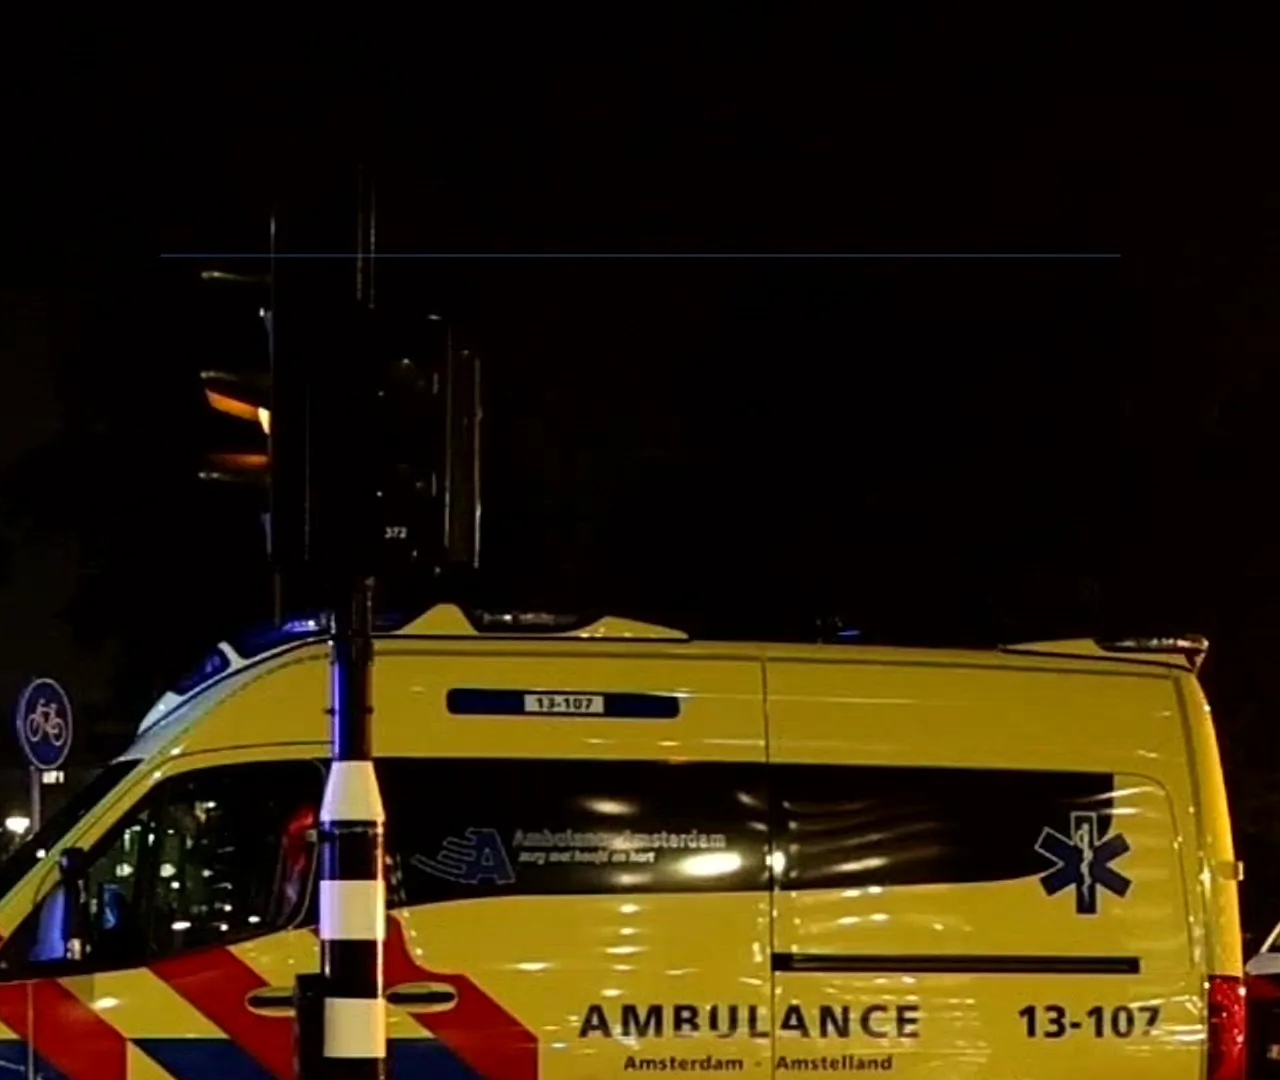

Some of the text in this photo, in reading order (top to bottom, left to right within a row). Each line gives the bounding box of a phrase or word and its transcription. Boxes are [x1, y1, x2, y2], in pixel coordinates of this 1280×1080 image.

[384, 525, 408, 540] 372
[535, 697, 593, 711] 13-107
[578, 1003, 920, 1039] AMBULANCE
[1017, 1004, 1161, 1039] 13-107
[624, 1055, 744, 1072] Amsterdam
[776, 1054, 893, 1072] Amstelland
